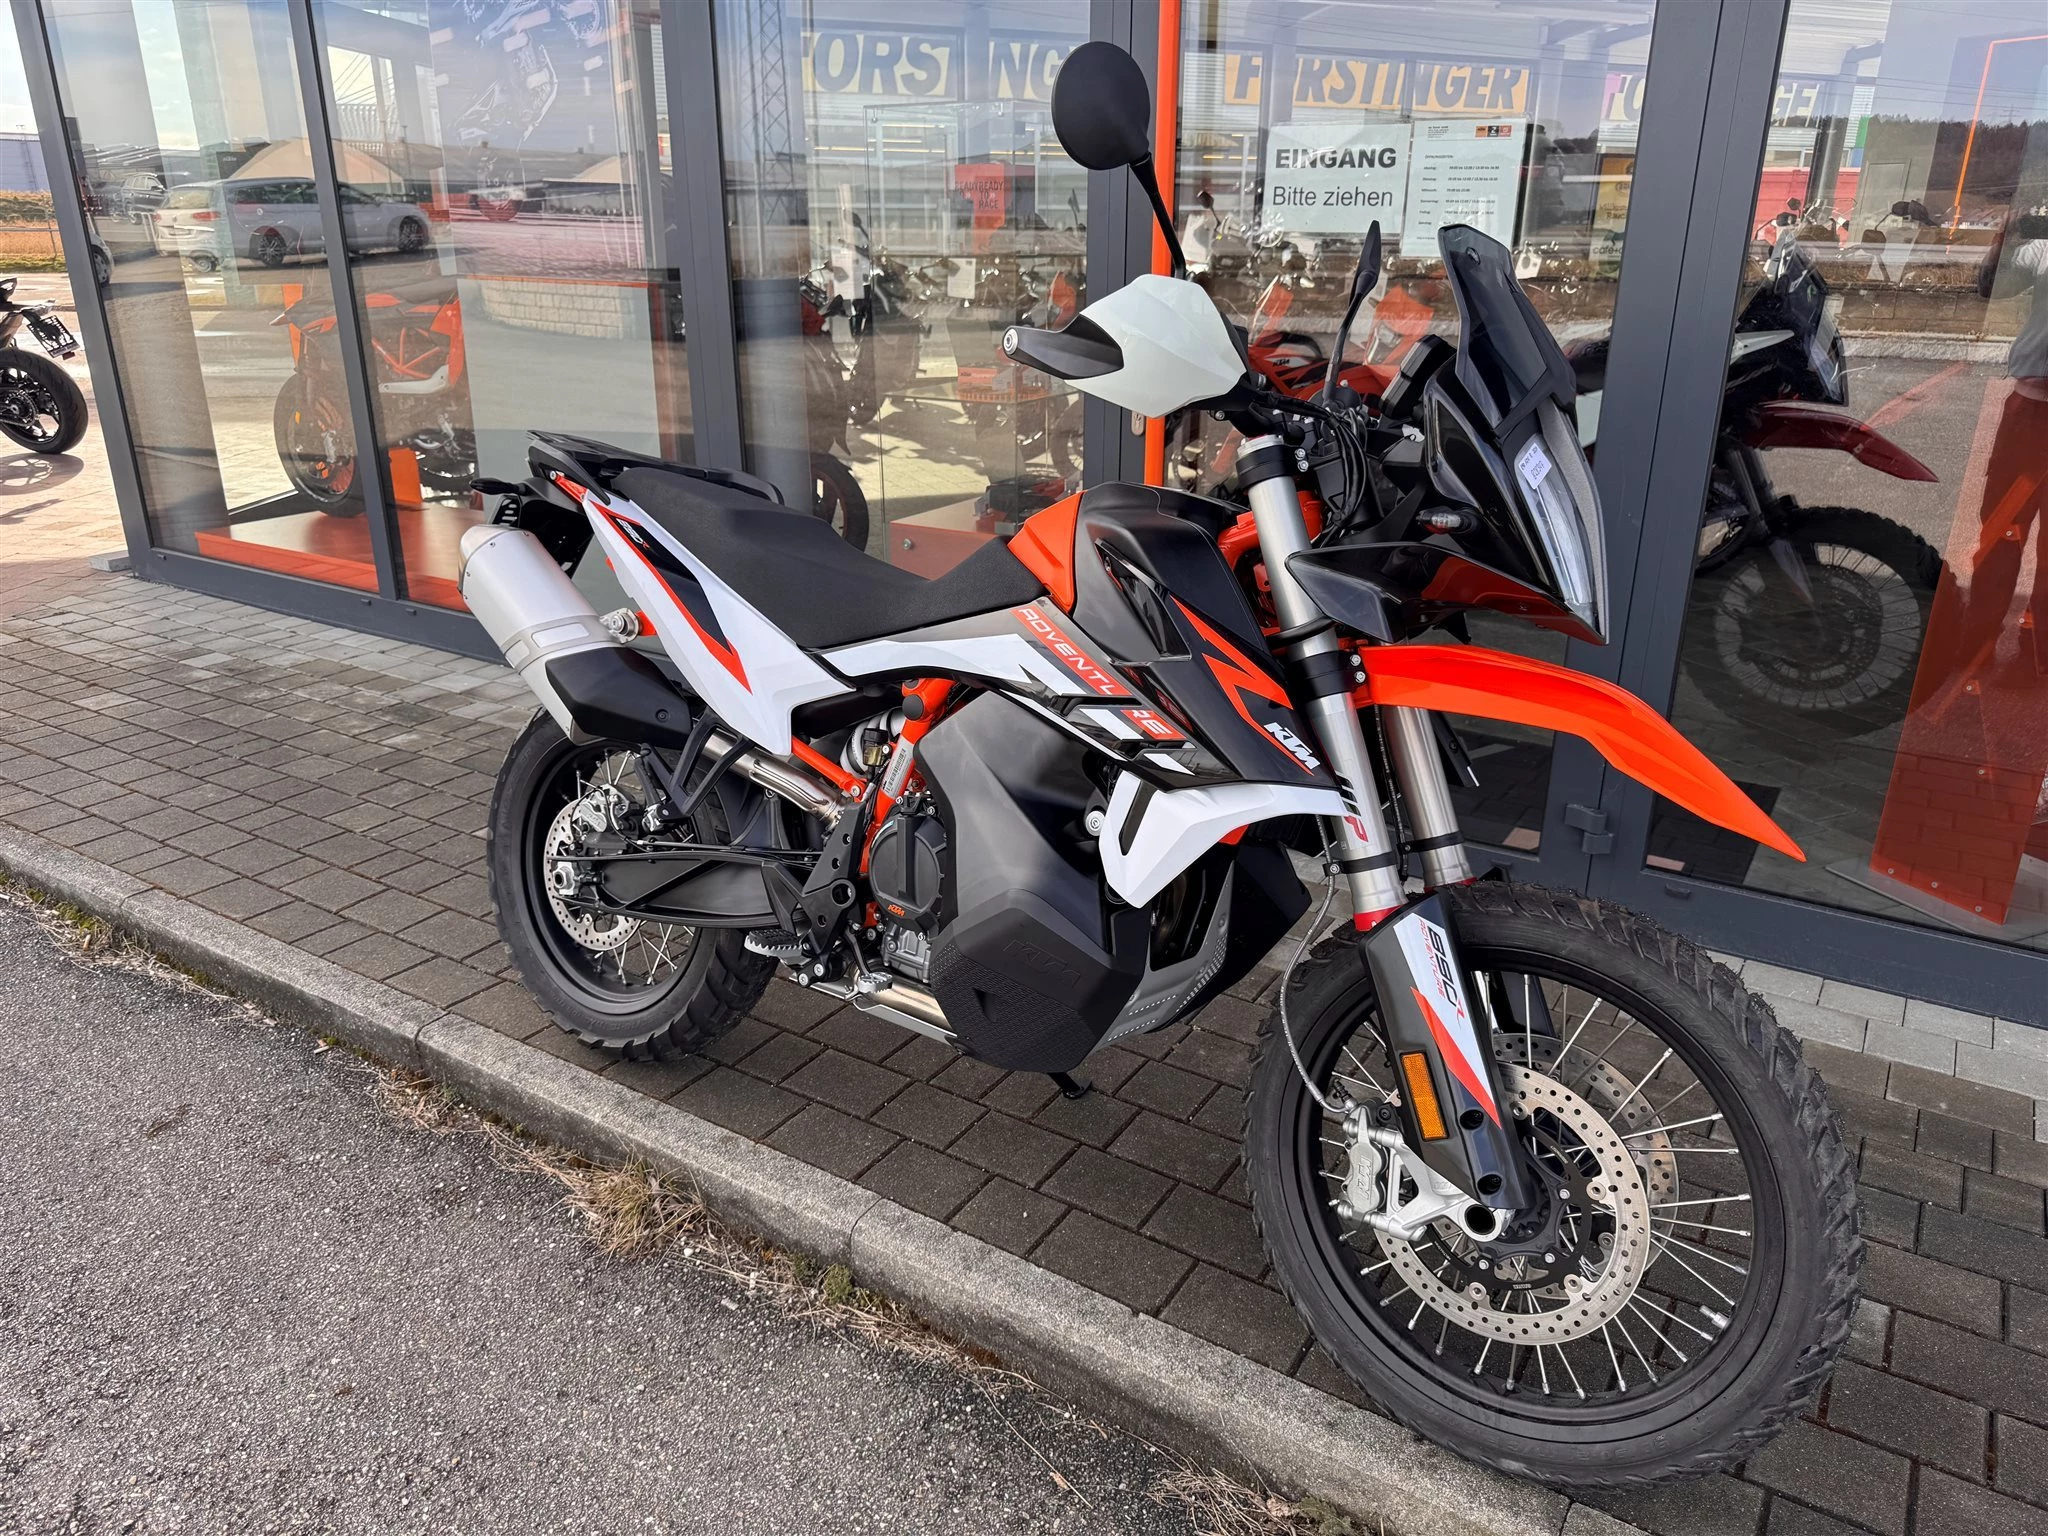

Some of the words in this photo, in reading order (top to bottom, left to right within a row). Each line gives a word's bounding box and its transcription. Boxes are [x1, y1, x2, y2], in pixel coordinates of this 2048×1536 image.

[1275, 147, 1397, 169] EINGANG
[978, 181, 1004, 191] READY
[1272, 186, 1317, 207] Bitte
[1323, 186, 1393, 207] ziehen
[1263, 721, 1321, 770] KTM
[1420, 919, 1446, 999] ADVENTURE
